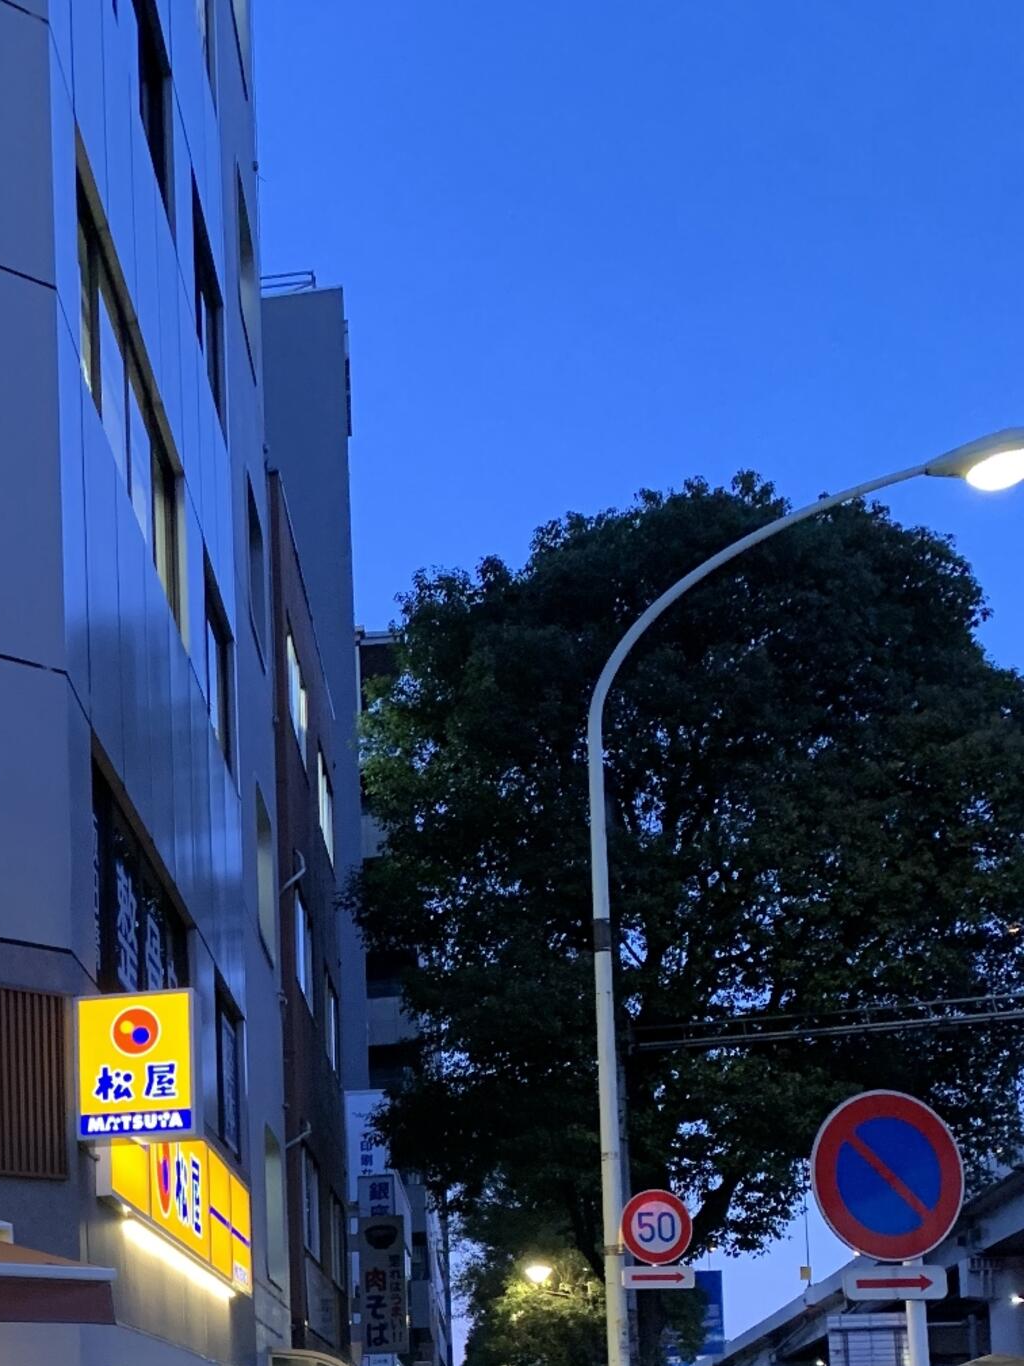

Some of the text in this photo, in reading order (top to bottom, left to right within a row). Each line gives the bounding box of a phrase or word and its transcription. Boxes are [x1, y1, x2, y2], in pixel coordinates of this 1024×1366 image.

[94, 1063, 176, 1100] 松屋
[86, 1111, 184, 1133] MATSUYA
[175, 1142, 202, 1234] 松屋
[636, 1211, 676, 1244] 50
[365, 1266, 389, 1347] 肉そば
